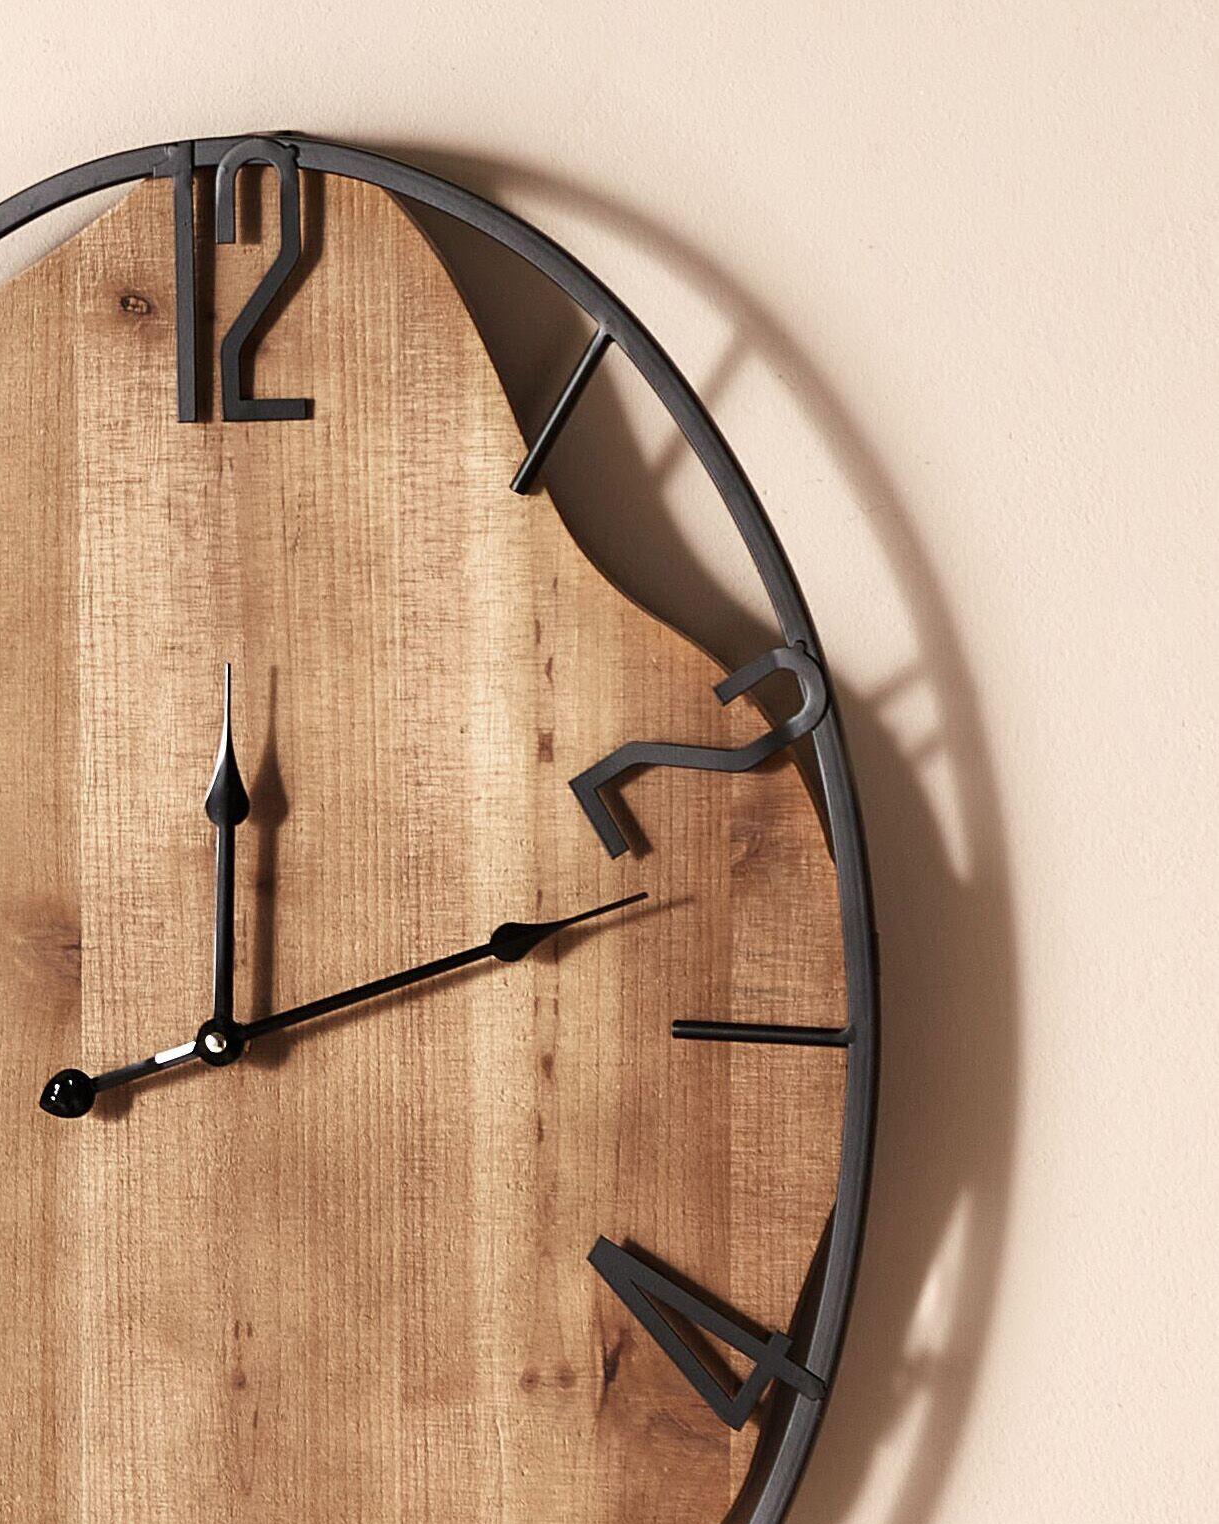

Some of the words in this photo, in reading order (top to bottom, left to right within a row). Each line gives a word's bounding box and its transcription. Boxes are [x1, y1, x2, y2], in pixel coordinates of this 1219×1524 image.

[174, 138, 313, 422] 12
[568, 643, 827, 860] 2
[586, 1234, 829, 1432] 4
